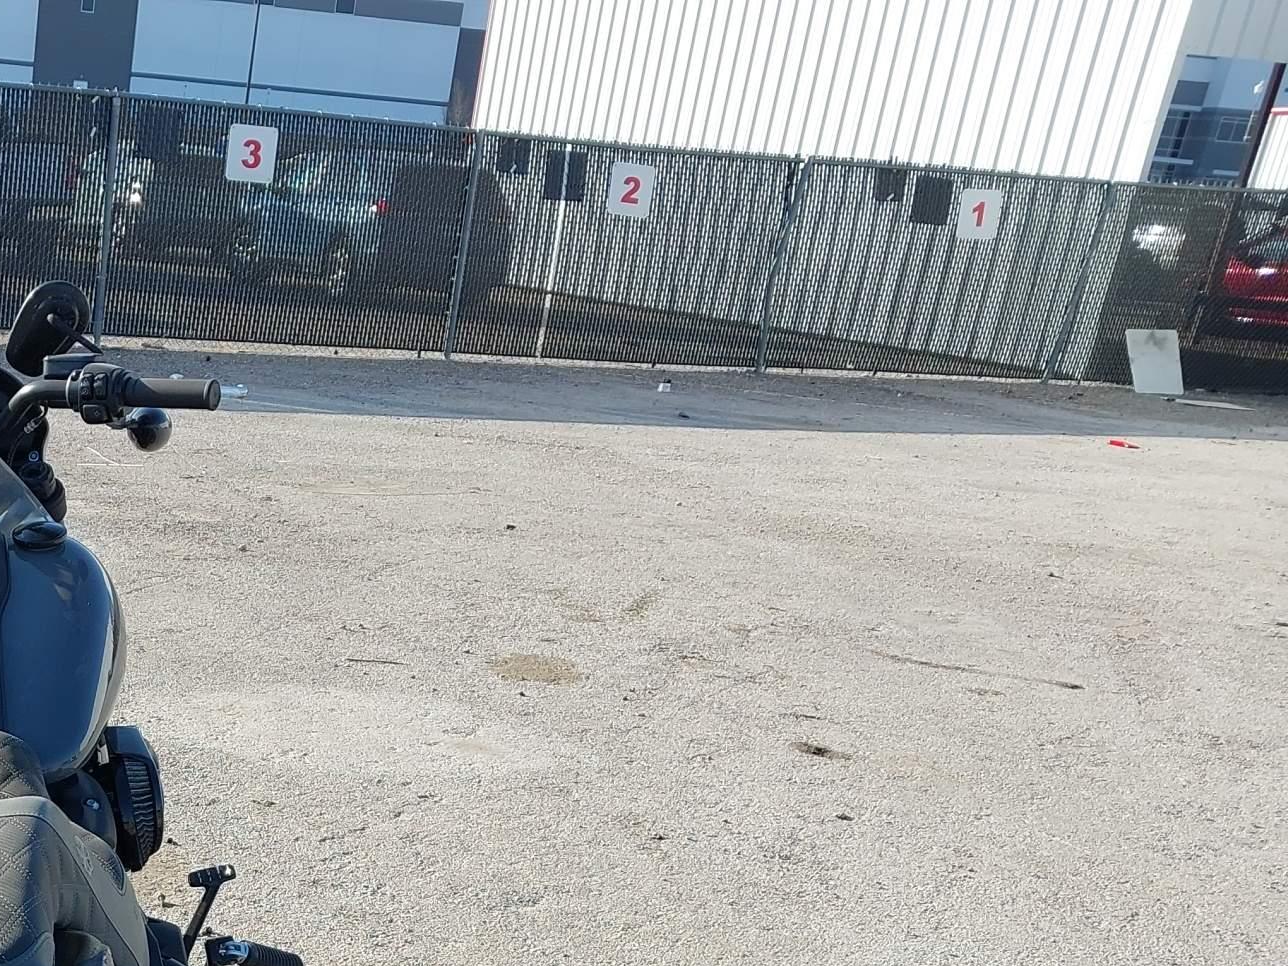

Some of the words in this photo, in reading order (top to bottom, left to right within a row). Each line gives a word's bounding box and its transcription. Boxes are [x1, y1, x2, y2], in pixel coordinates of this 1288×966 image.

[241, 139, 263, 170] 3
[620, 176, 642, 206] 2
[972, 201, 987, 227] 1
